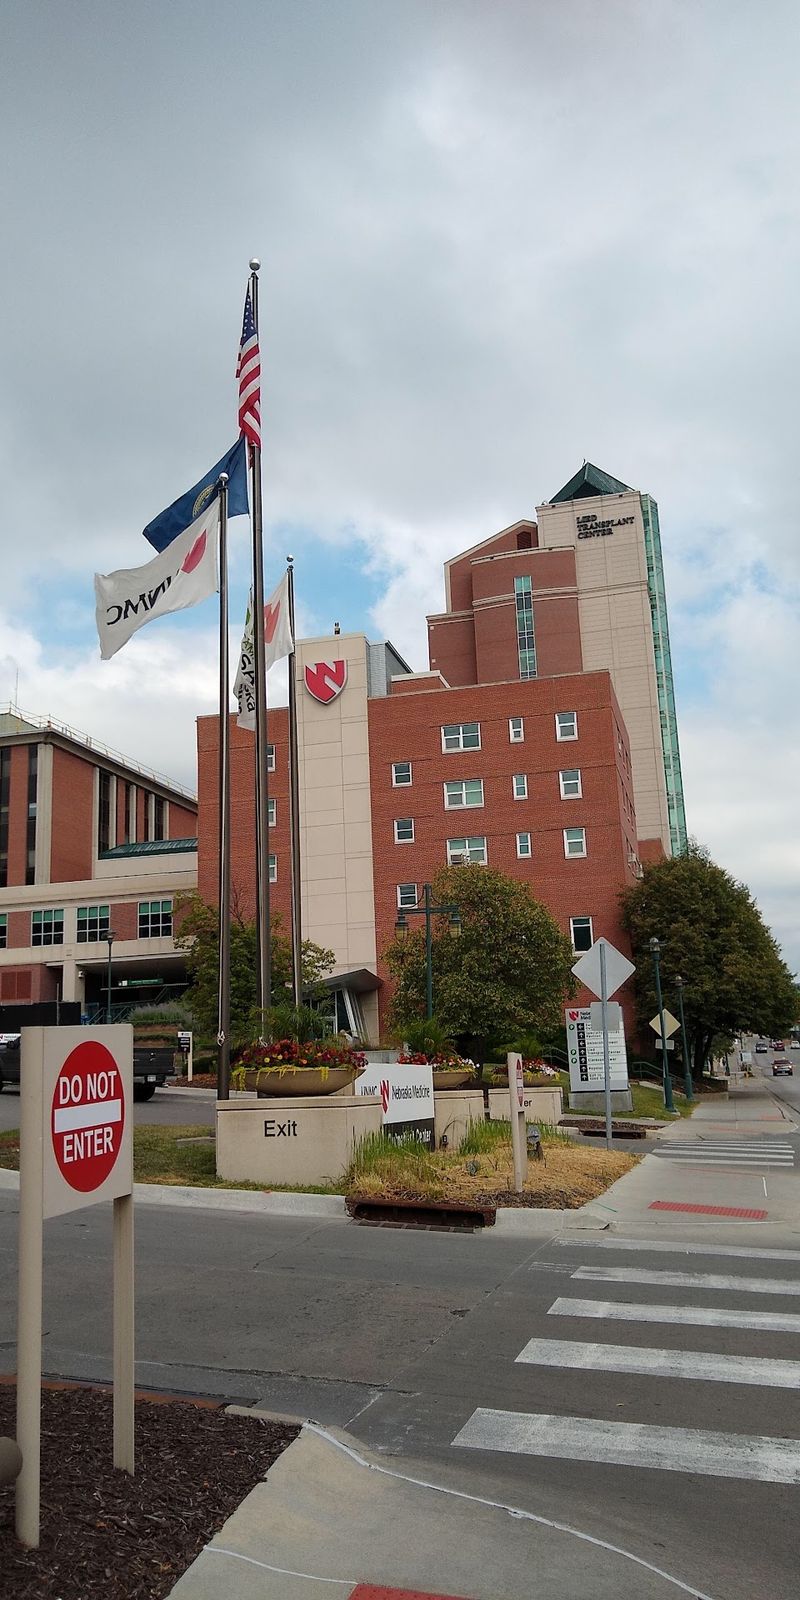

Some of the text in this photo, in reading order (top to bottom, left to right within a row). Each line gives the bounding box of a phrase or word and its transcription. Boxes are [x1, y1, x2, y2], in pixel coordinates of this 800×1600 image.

[577, 516, 635, 531] TRANSPLANT
[578, 528, 613, 539] CENTER
[59, 1070, 118, 1105] DO NOT
[391, 1085, 412, 1100] Nebraska
[412, 1085, 430, 1099] Medicine
[264, 1119, 298, 1138] Exit
[63, 1126, 114, 1164] ENTER
